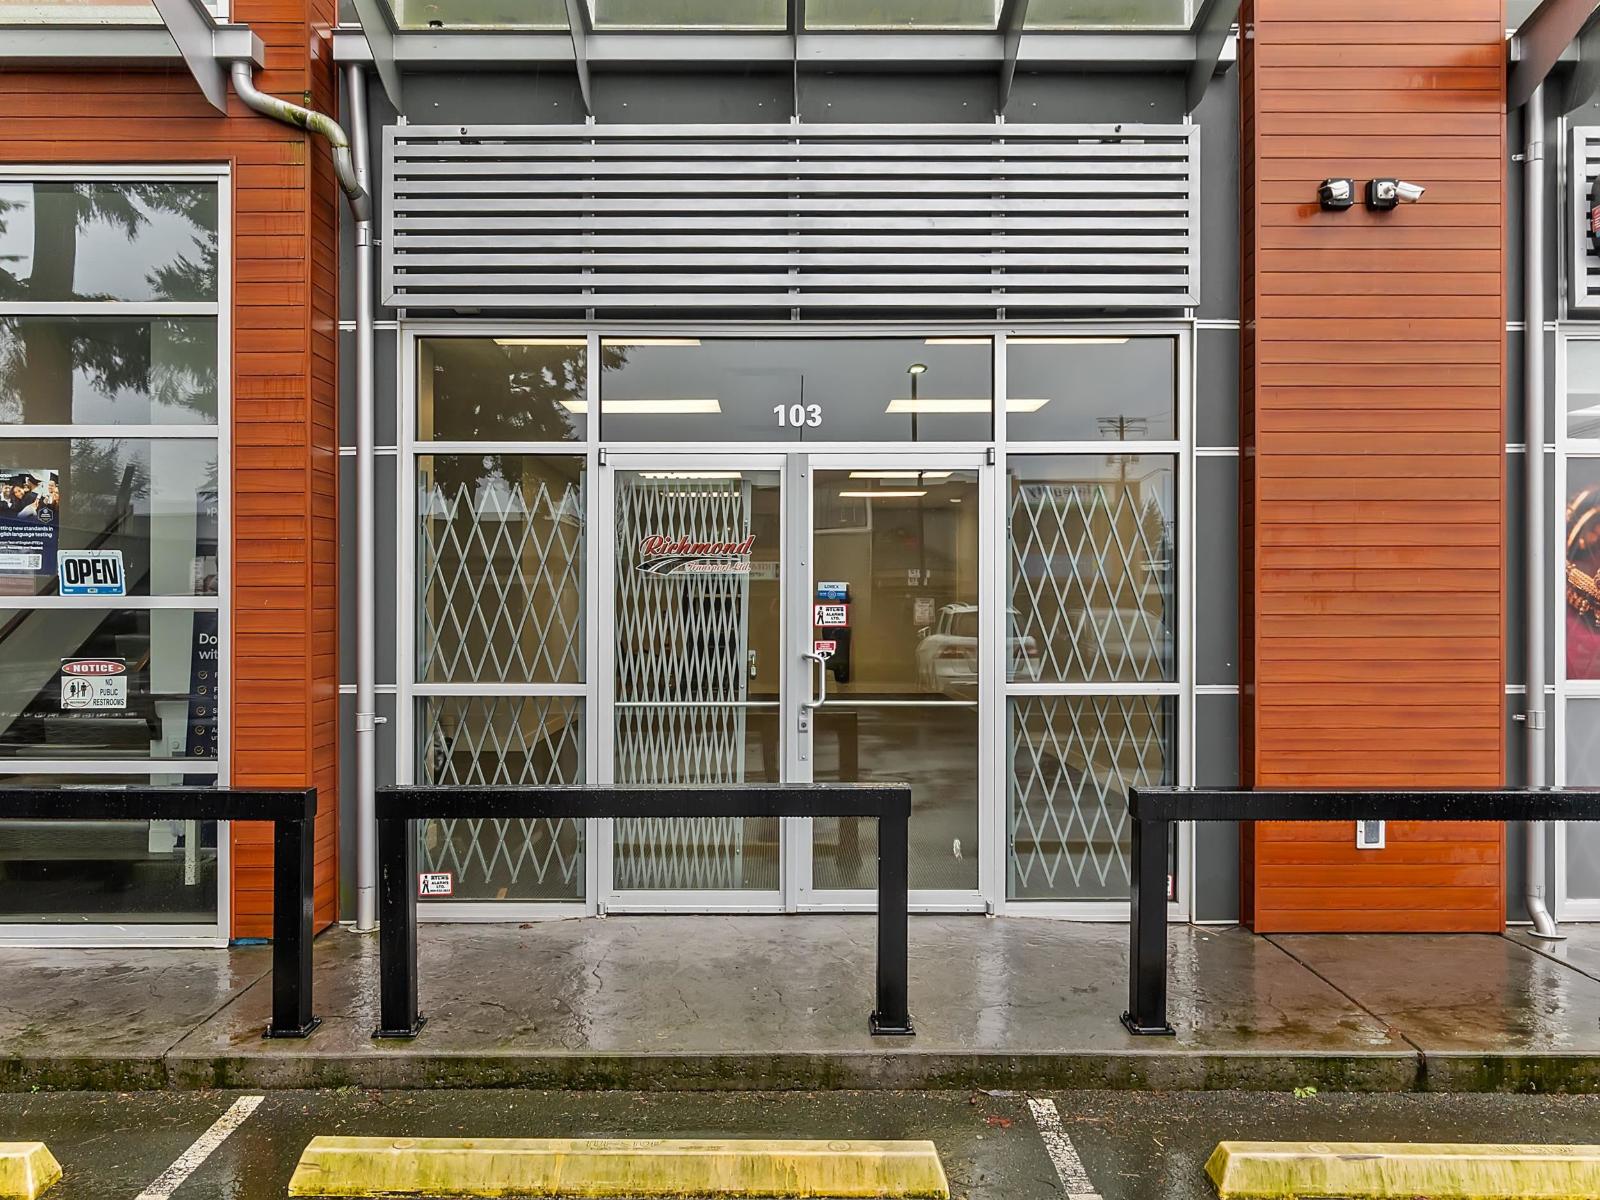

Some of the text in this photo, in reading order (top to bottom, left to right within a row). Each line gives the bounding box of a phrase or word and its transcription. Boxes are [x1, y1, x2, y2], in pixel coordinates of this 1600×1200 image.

[773, 404, 822, 427] 103
[640, 535, 756, 555] Richmond
[65, 559, 118, 584] OPEN
[199, 648, 218, 660] wit
[73, 664, 114, 672] NOTICE
[105, 678, 113, 686] NO
[100, 688, 118, 696] PUBLIC
[93, 698, 124, 706] RESTROOMS
